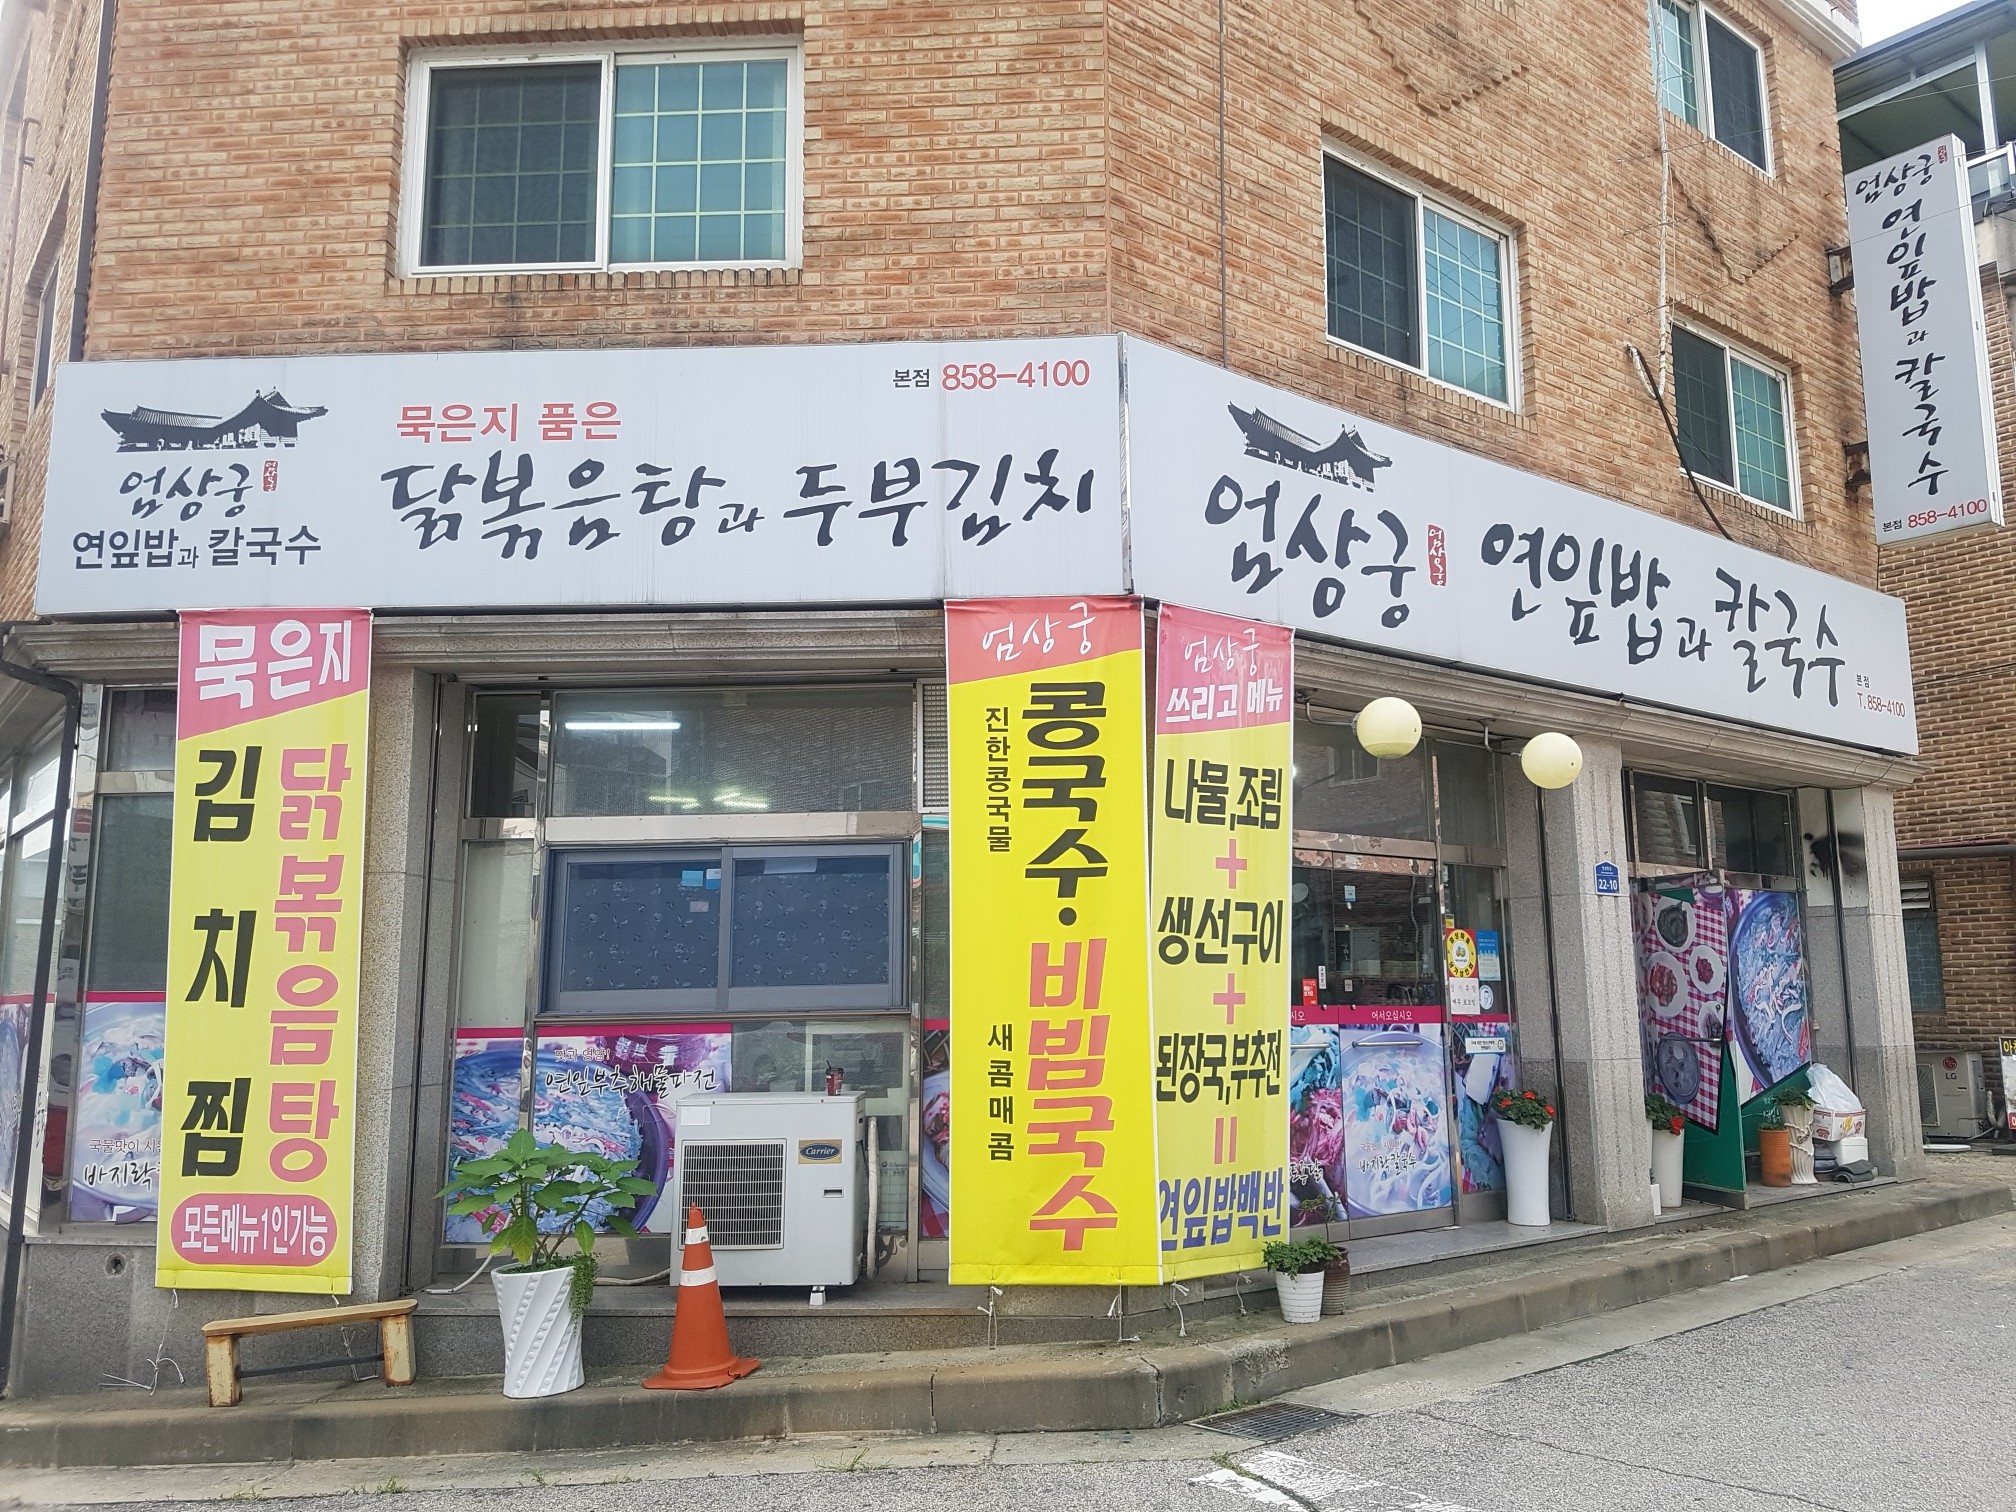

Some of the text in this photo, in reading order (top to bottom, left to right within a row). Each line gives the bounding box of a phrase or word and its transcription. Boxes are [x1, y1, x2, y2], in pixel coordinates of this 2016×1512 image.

[1856, 154, 1936, 204] 엄상궁
[892, 360, 1090, 390] 본점 858-4100
[396, 401, 622, 443] 묵은지 품은
[1894, 352, 1949, 495] 칼국수
[118, 461, 251, 521] 엄상궁
[783, 448, 1096, 548] 두부김치
[1882, 498, 1988, 532] 본점 858-4100
[72, 525, 322, 570] 연잎밥과 칼국수
[1204, 475, 1417, 629] 엄상궁
[982, 602, 1097, 662] 엄상궁
[1184, 627, 1260, 677] 엄상궁
[1715, 567, 1845, 707] 칼국수
[194, 619, 352, 710] 묵은지
[1856, 674, 1870, 688] 본점
[1165, 678, 1284, 723] 쓰리고 메뉴
[985, 706, 1012, 853] 진한콩국물
[1598, 879, 1618, 890] 22-10
[1157, 896, 1284, 965] 생선구이
[180, 745, 263, 1177] 김치찜
[268, 743, 352, 1183] 닭볶음탕
[1371, 1010, 1412, 1021] 어서오십시오
[546, 1064, 717, 1098] 연잎부추해물파전
[987, 1023, 1014, 1161] 새콤매콤
[1945, 1072, 1957, 1080] LG
[90, 1139, 139, 1153] 국물맛이
[805, 1147, 835, 1155] Carrier
[84, 1162, 160, 1190] 바지락
[1160, 1167, 1284, 1251] 연잎밥백반
